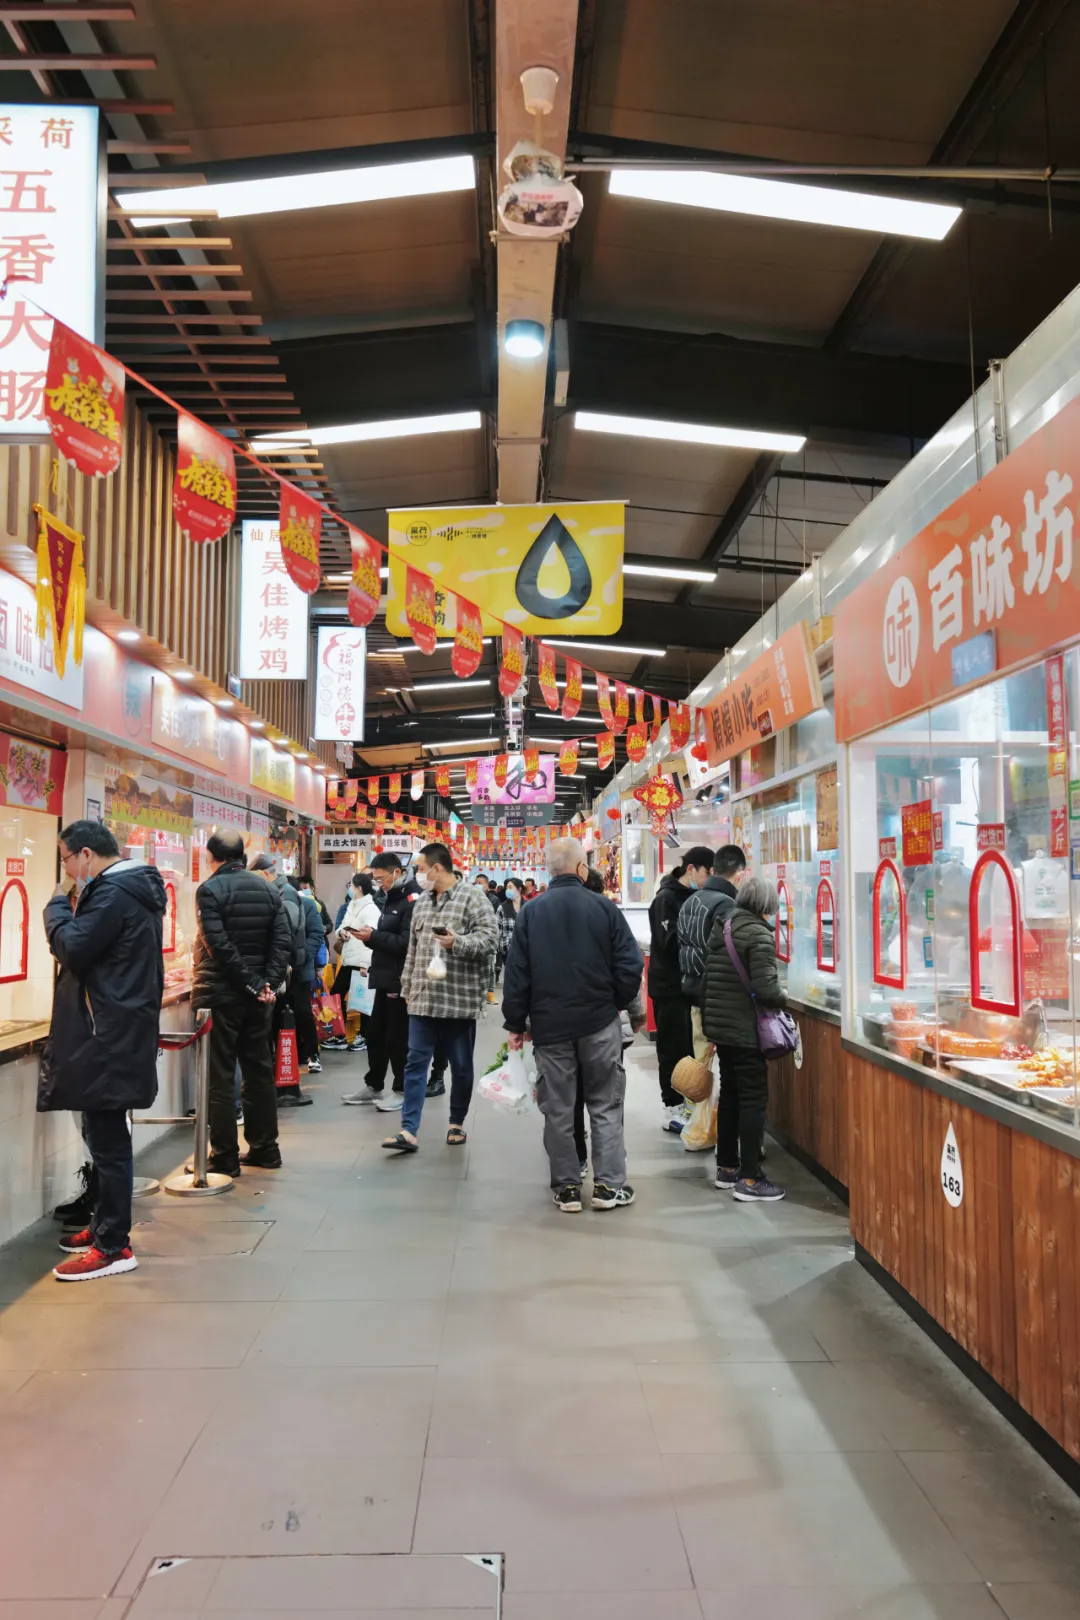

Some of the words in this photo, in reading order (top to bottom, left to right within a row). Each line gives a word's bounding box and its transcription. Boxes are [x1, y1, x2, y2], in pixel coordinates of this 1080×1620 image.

[0, 169, 57, 421] 五香大肠
[259, 551, 290, 673] 吴佳烤鸡
[928, 470, 1075, 653] 百味坊
[886, 577, 915, 684] 味
[324, 838, 367, 847] 高庄大馒头
[943, 1171, 961, 1197] 163
